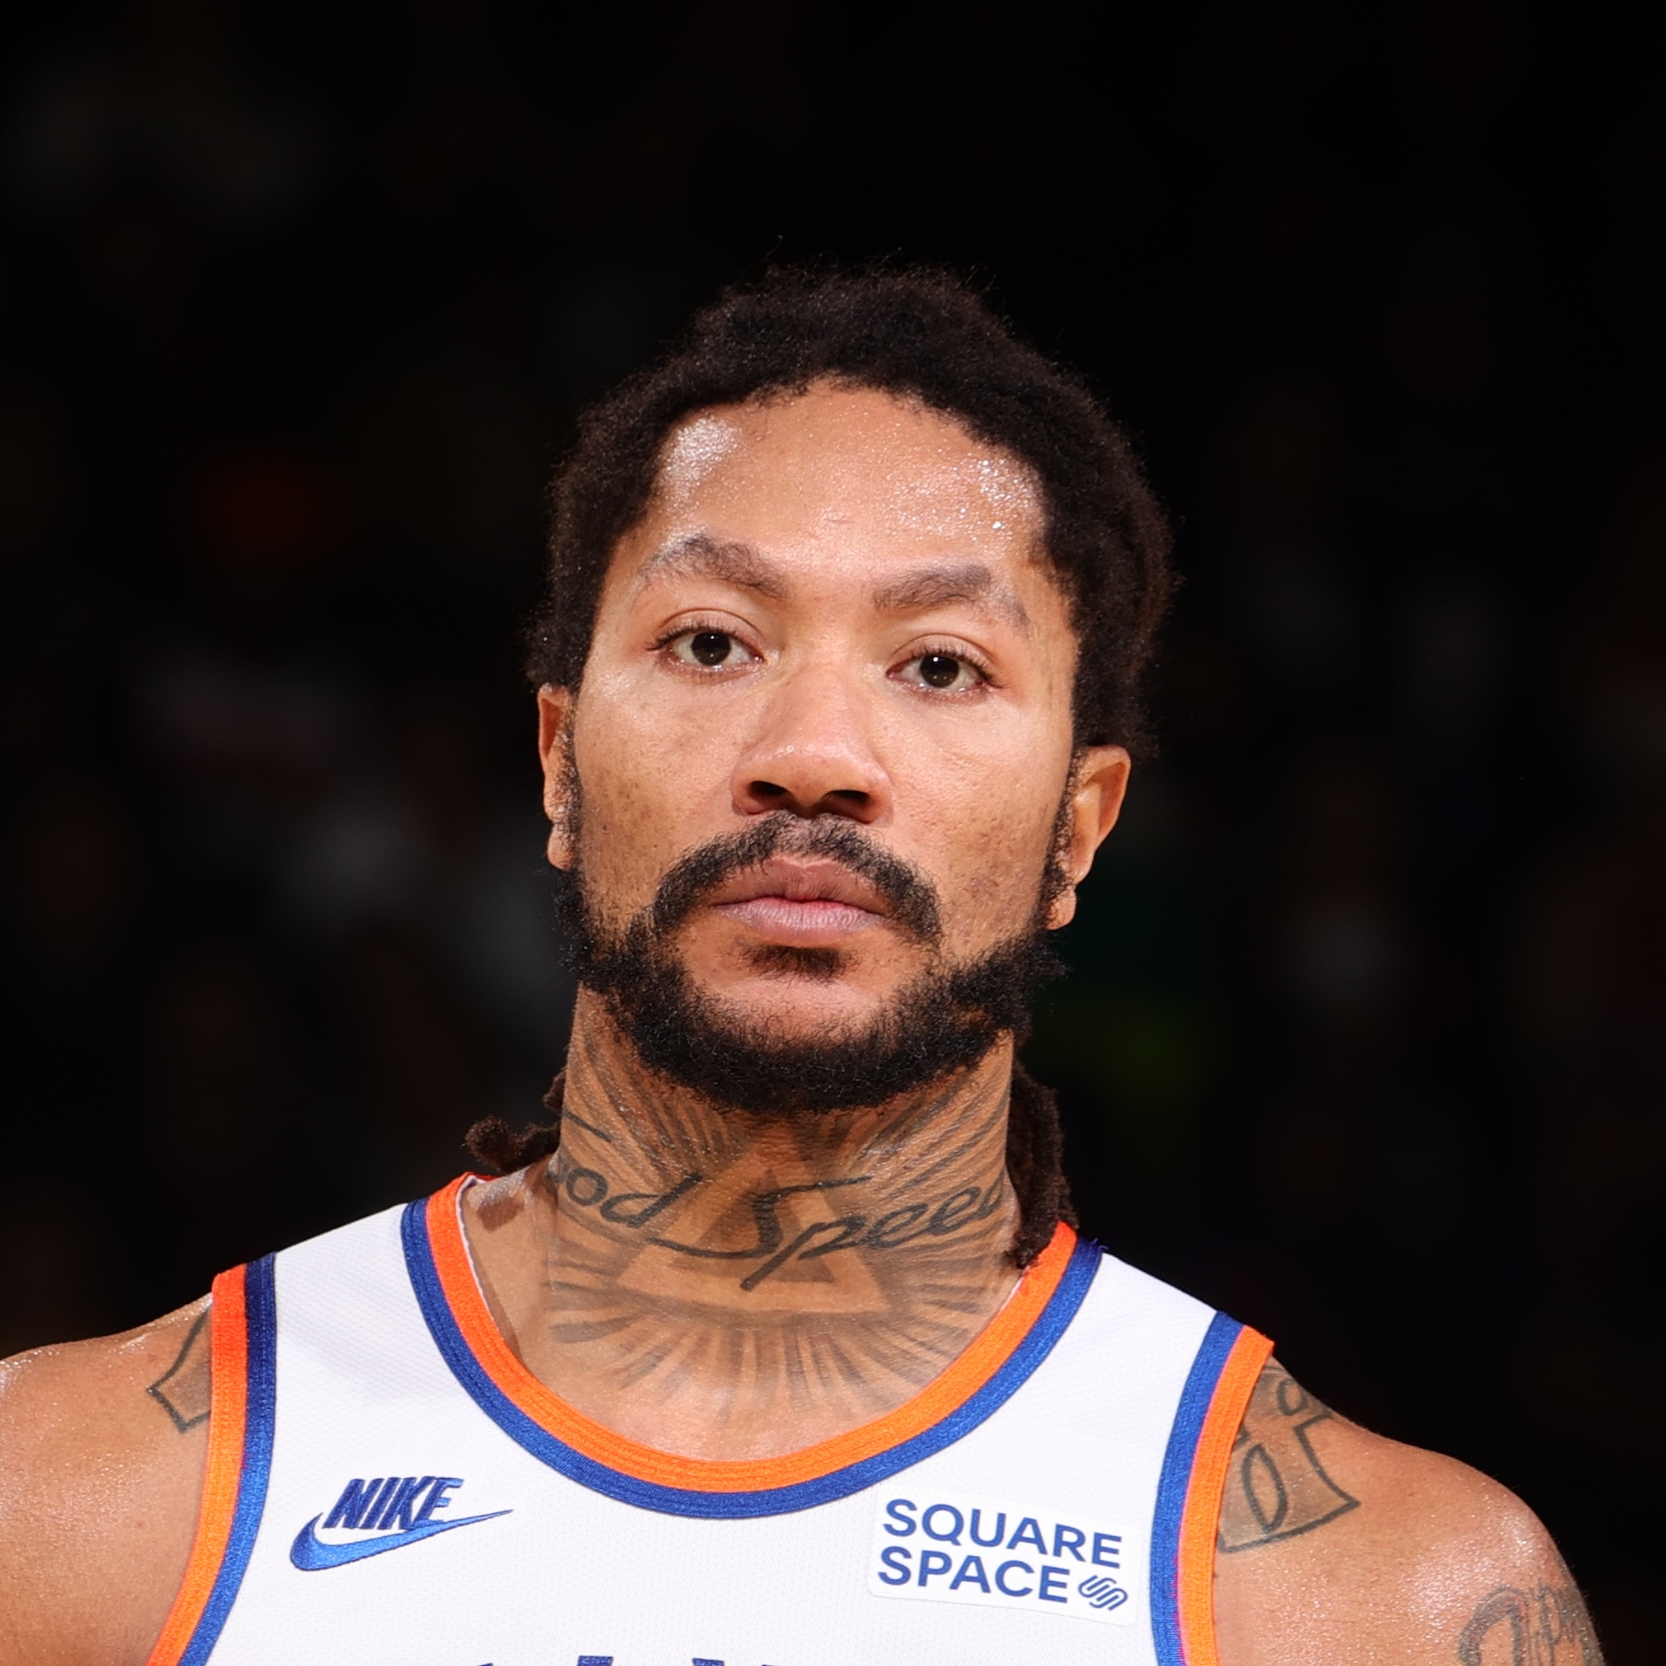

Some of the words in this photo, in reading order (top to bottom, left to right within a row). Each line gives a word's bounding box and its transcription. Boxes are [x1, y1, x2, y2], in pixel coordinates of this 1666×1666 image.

[322, 1475, 465, 1531] NIKE
[883, 1498, 1123, 1569] SQUARE
[877, 1545, 1071, 1604] SPACE
